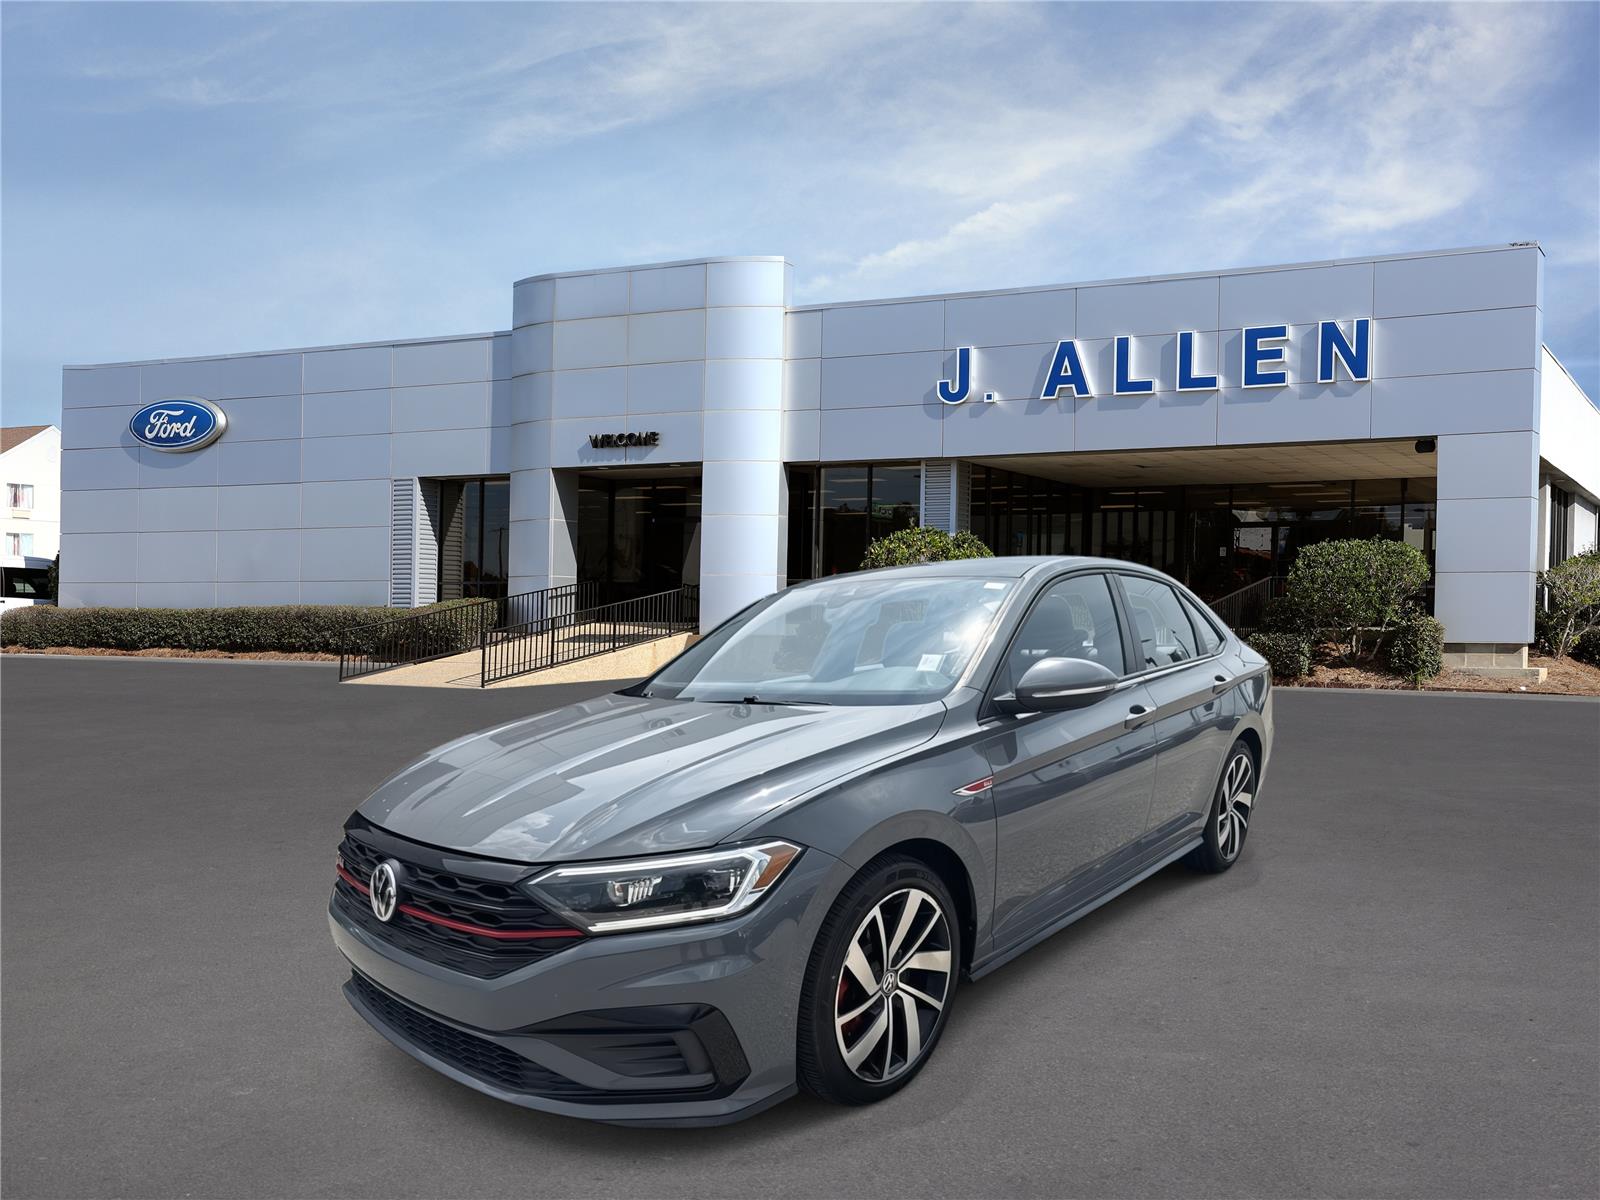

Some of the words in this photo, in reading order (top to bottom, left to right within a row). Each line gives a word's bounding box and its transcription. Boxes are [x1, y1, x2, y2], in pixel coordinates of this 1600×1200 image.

[937, 346, 998, 404] J.
[1039, 316, 1373, 400] ALLEN
[144, 409, 198, 439] Ford
[588, 431, 660, 448] WELCOME
